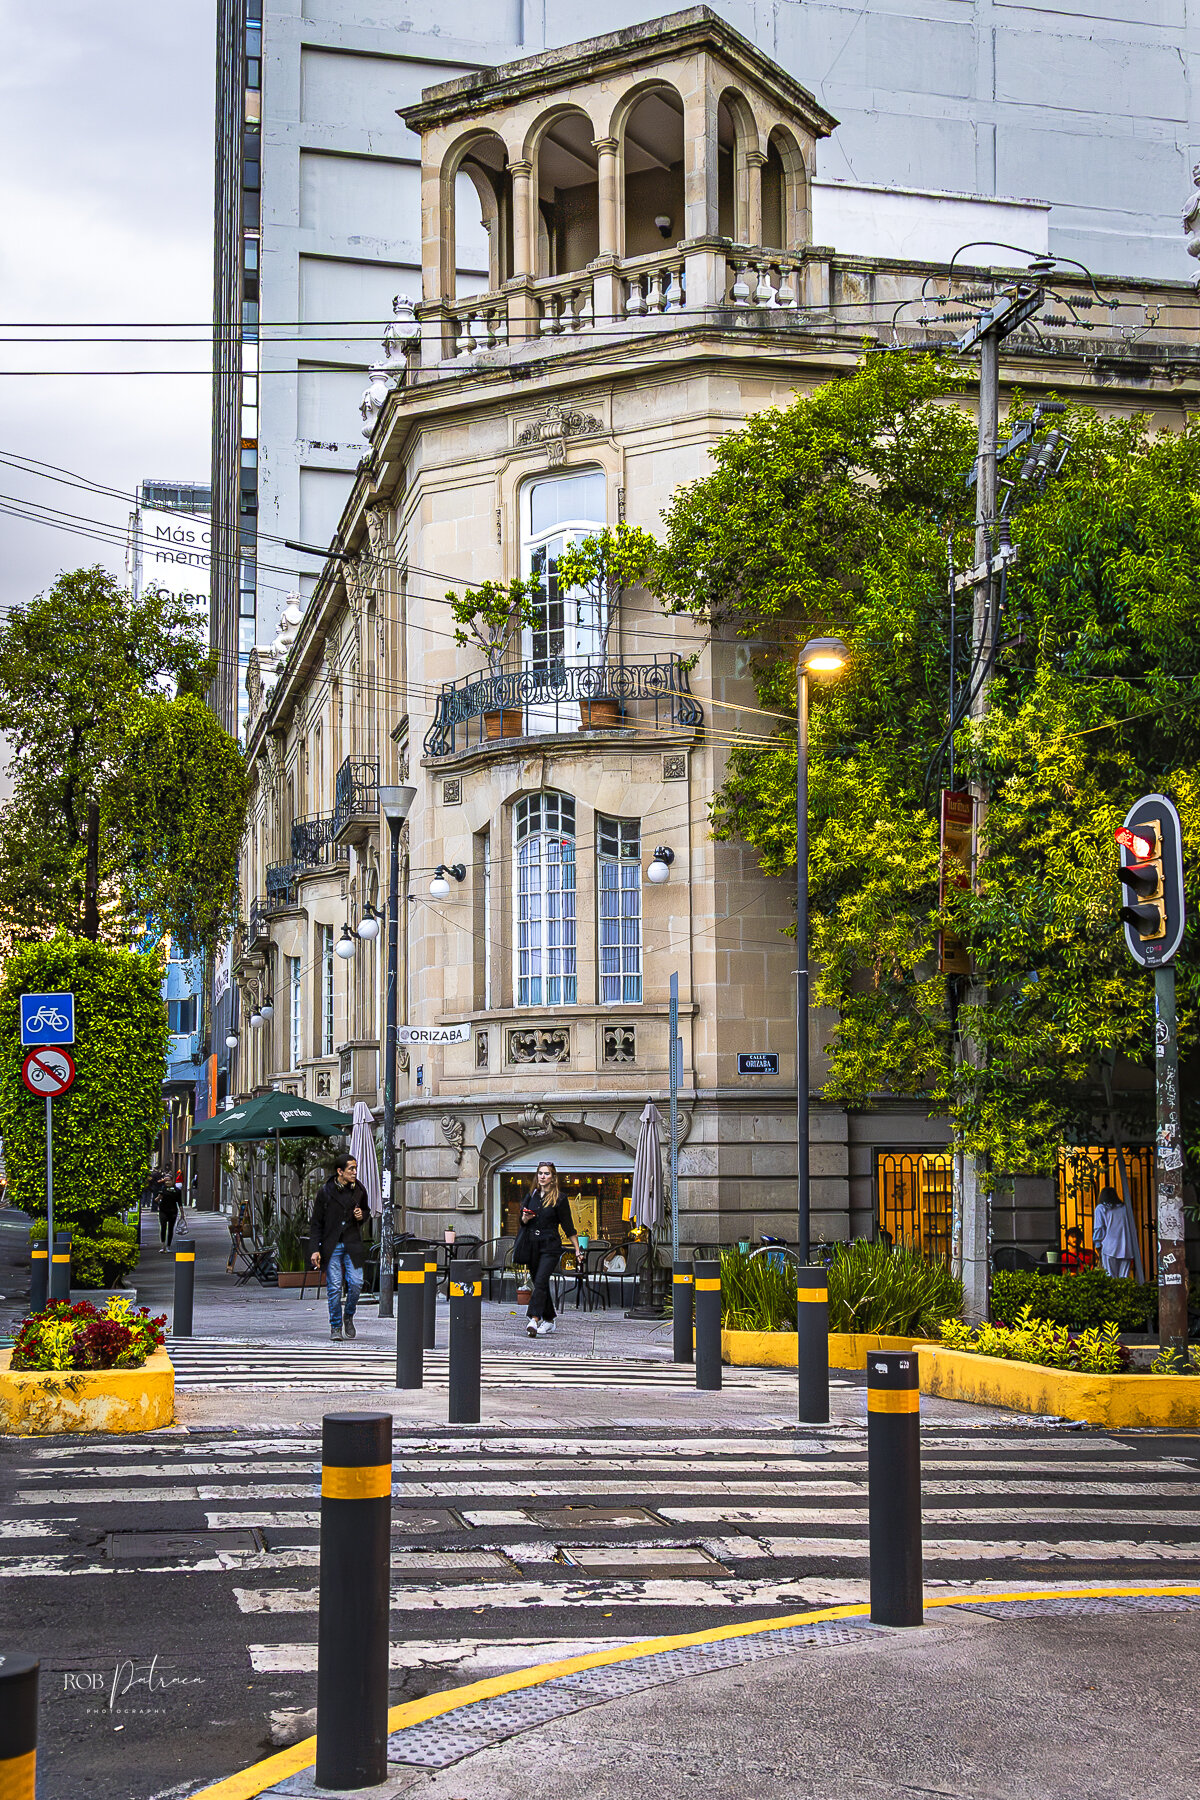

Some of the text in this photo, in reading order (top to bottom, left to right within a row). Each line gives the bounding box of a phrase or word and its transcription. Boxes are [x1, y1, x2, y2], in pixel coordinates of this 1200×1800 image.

[156, 525, 196, 542] Más
[410, 1029, 463, 1041] ORIZABA
[745, 1060, 772, 1068] ORIZABA
